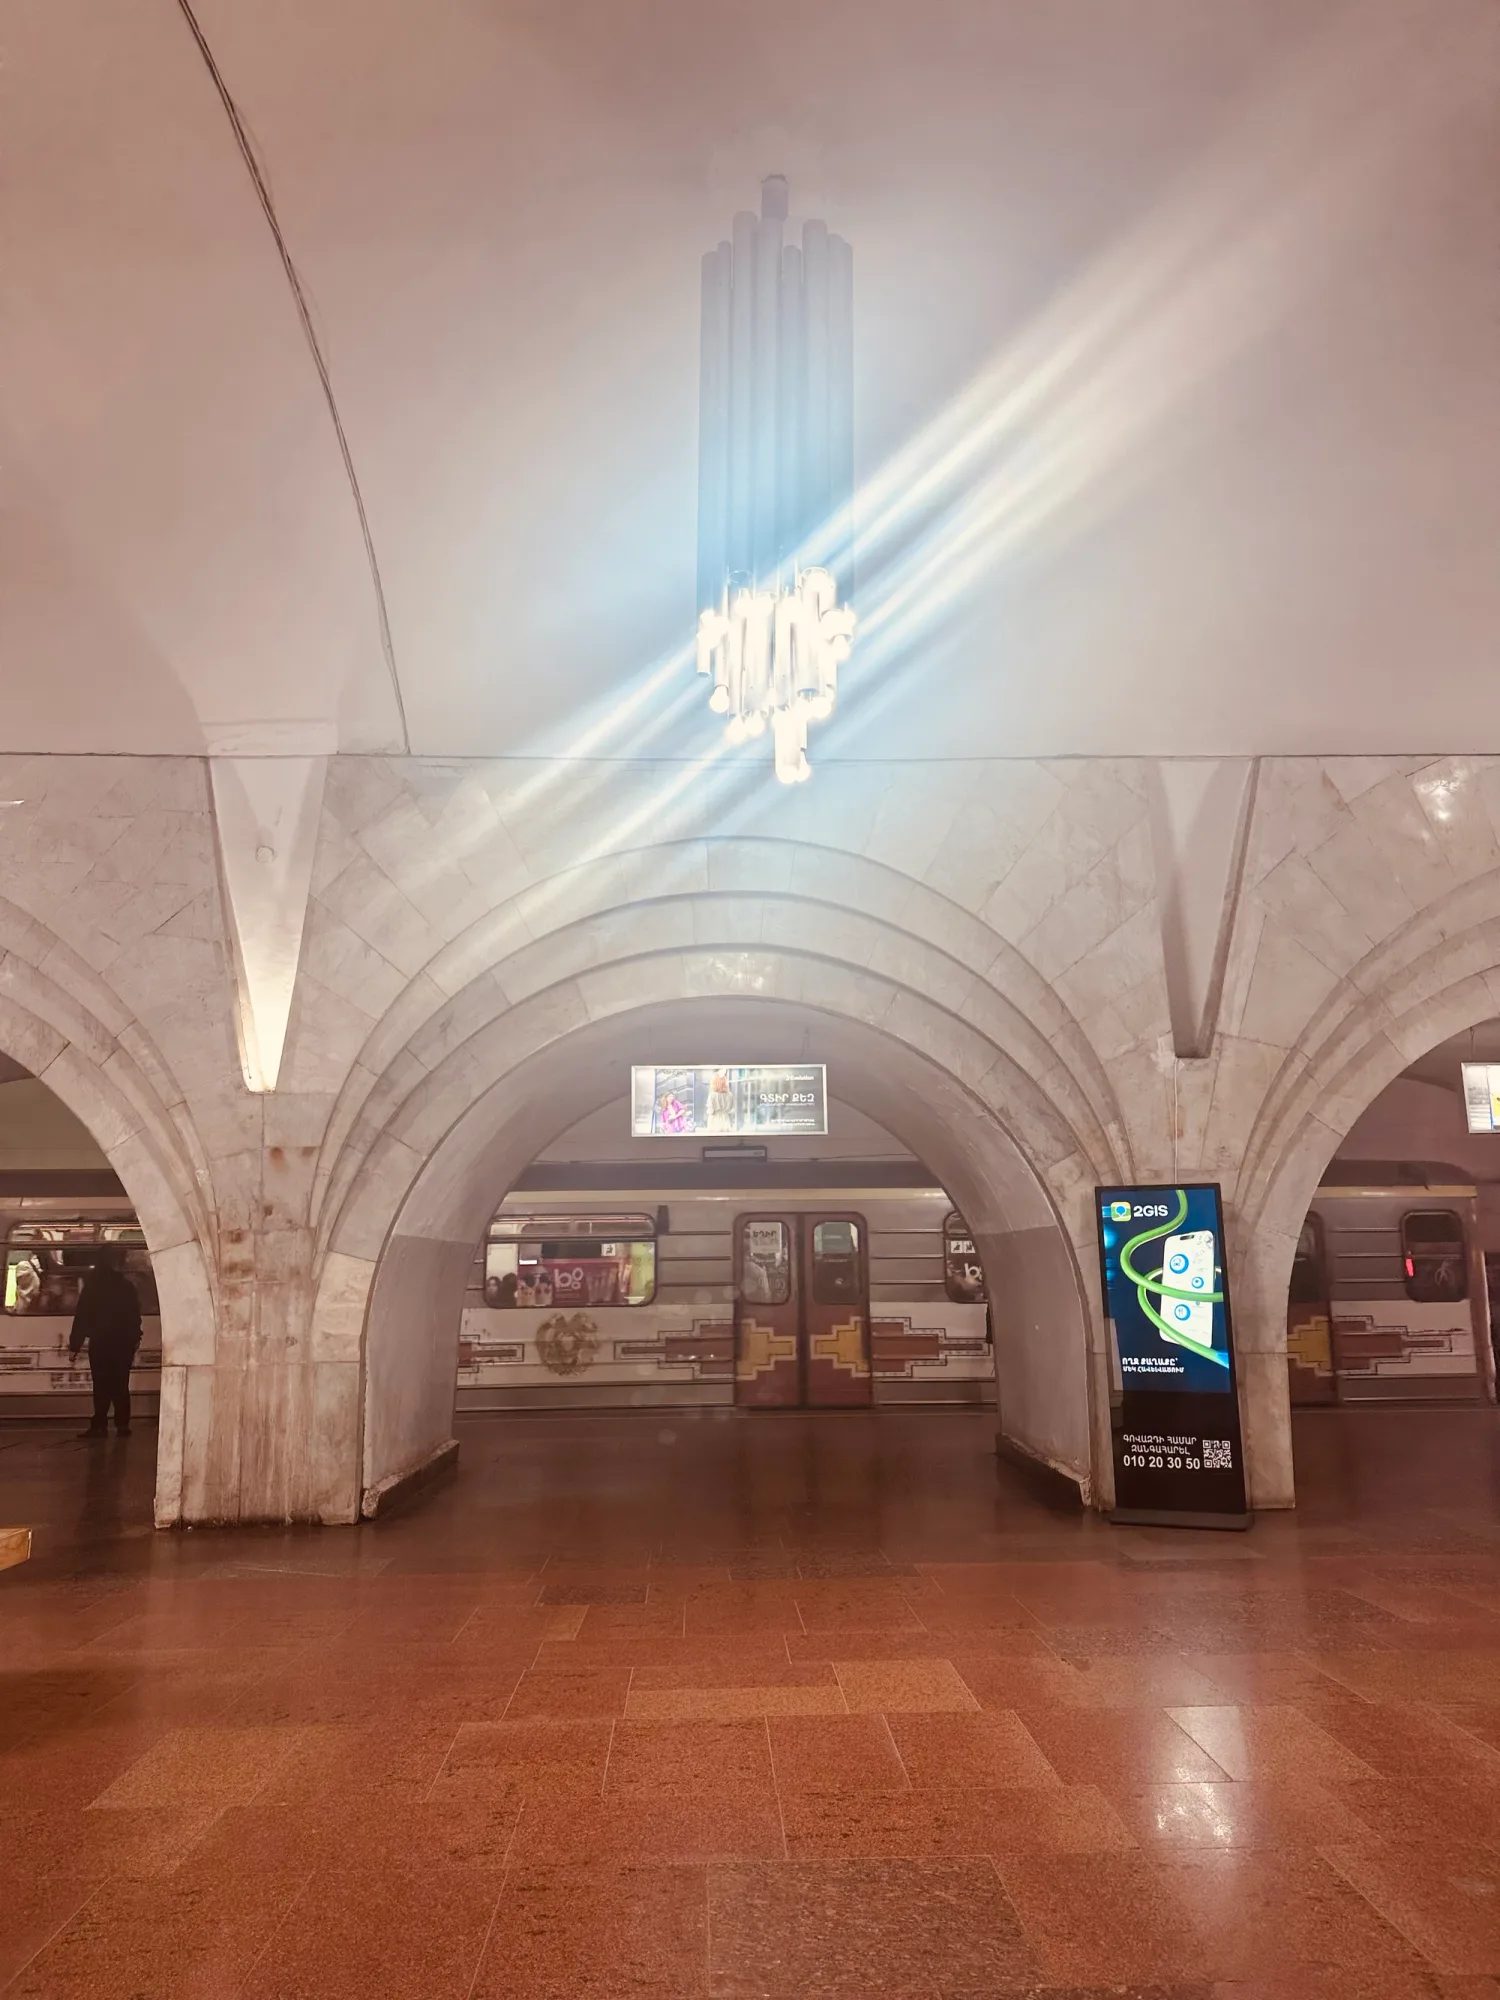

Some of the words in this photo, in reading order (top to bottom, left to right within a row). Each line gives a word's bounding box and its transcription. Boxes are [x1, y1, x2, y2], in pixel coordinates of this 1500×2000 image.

[760, 1093, 789, 1102] ԳՏԻՐ
[792, 1093, 815, 1102] ՔԵԶ
[1133, 1204, 1169, 1217] 2GIS
[1122, 1357, 1140, 1366] ՈՂՋ
[1123, 1434, 1165, 1444] ԳՈՎԱԶԴԻ
[1166, 1436, 1197, 1445] ՀԱՄԱՐ
[1131, 1444, 1191, 1455] ԶԱՆԳԱՀԱՐԵԼ
[1123, 1454, 1145, 1467] 010
[1148, 1456, 1163, 1468] 20
[1167, 1456, 1182, 1469] 30
[1185, 1457, 1200, 1469] 50
